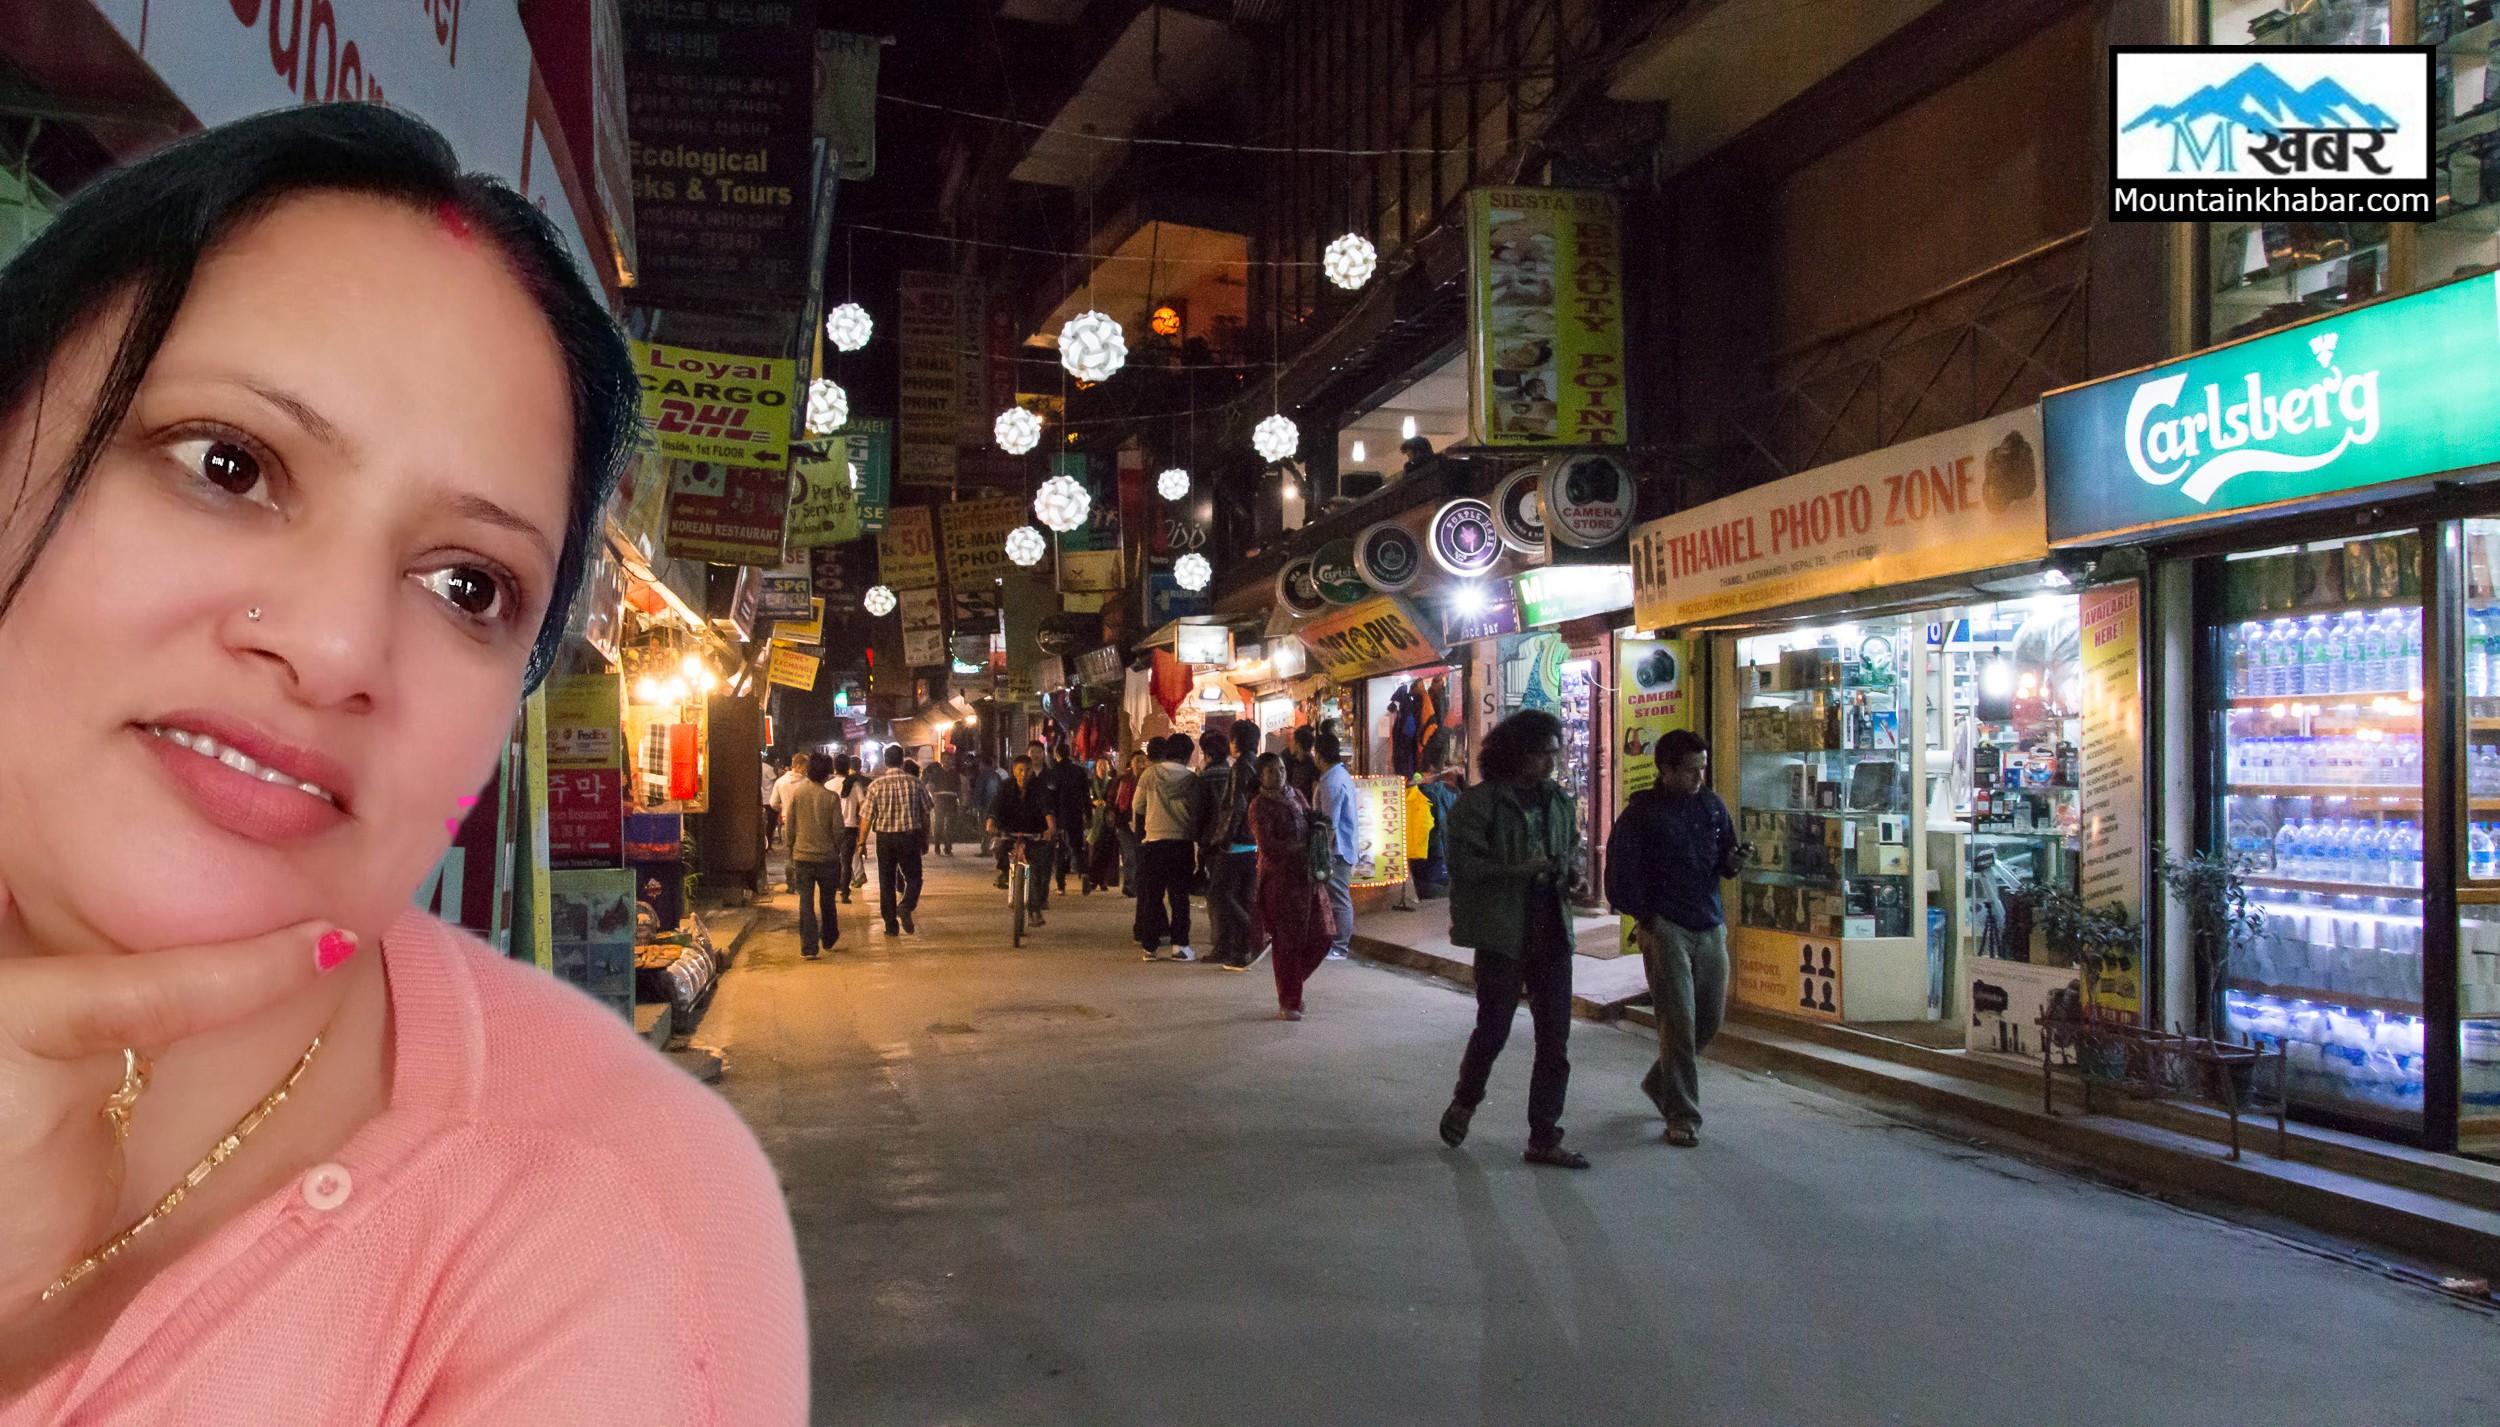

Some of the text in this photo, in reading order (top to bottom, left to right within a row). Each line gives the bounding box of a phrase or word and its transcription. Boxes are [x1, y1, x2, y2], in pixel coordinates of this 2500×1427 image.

[686, 177, 705, 202] &
[716, 179, 792, 206] Tours
[1490, 193, 1567, 211] SIESTA
[1574, 222, 1616, 334] BEAUTY
[651, 350, 772, 381] Loyal
[640, 374, 787, 407] CARGO
[902, 397, 949, 410] PRINT
[1574, 353, 1618, 444] POINT
[656, 399, 753, 441] DHL
[2125, 362, 2381, 490] Carlsberg
[696, 443, 711, 456] 1st
[713, 445, 745, 459] FLOOR
[812, 480, 850, 500] Per Kg
[802, 502, 846, 518] Service
[1563, 508, 1622, 518] CAMERA
[1573, 519, 1613, 530] STORE
[1667, 454, 1981, 579] THAMEL PHOTO ZONE
[671, 519, 780, 541] KOREAN RESTAURANT
[901, 528, 932, 557] 50
[2084, 590, 2136, 628] AVAILABLE
[1318, 614, 1420, 667] OCTOPUS
[1483, 622, 1499, 636] Bar
[1628, 690, 1683, 705] CAMERA
[1634, 704, 1677, 719] STORE
[578, 729, 608, 741] FedEx
[548, 773, 608, 805] 주막
[1382, 790, 1399, 835] BEAUTY
[1382, 843, 1401, 880] POINT
[1759, 980, 1787, 997] PHOTO
